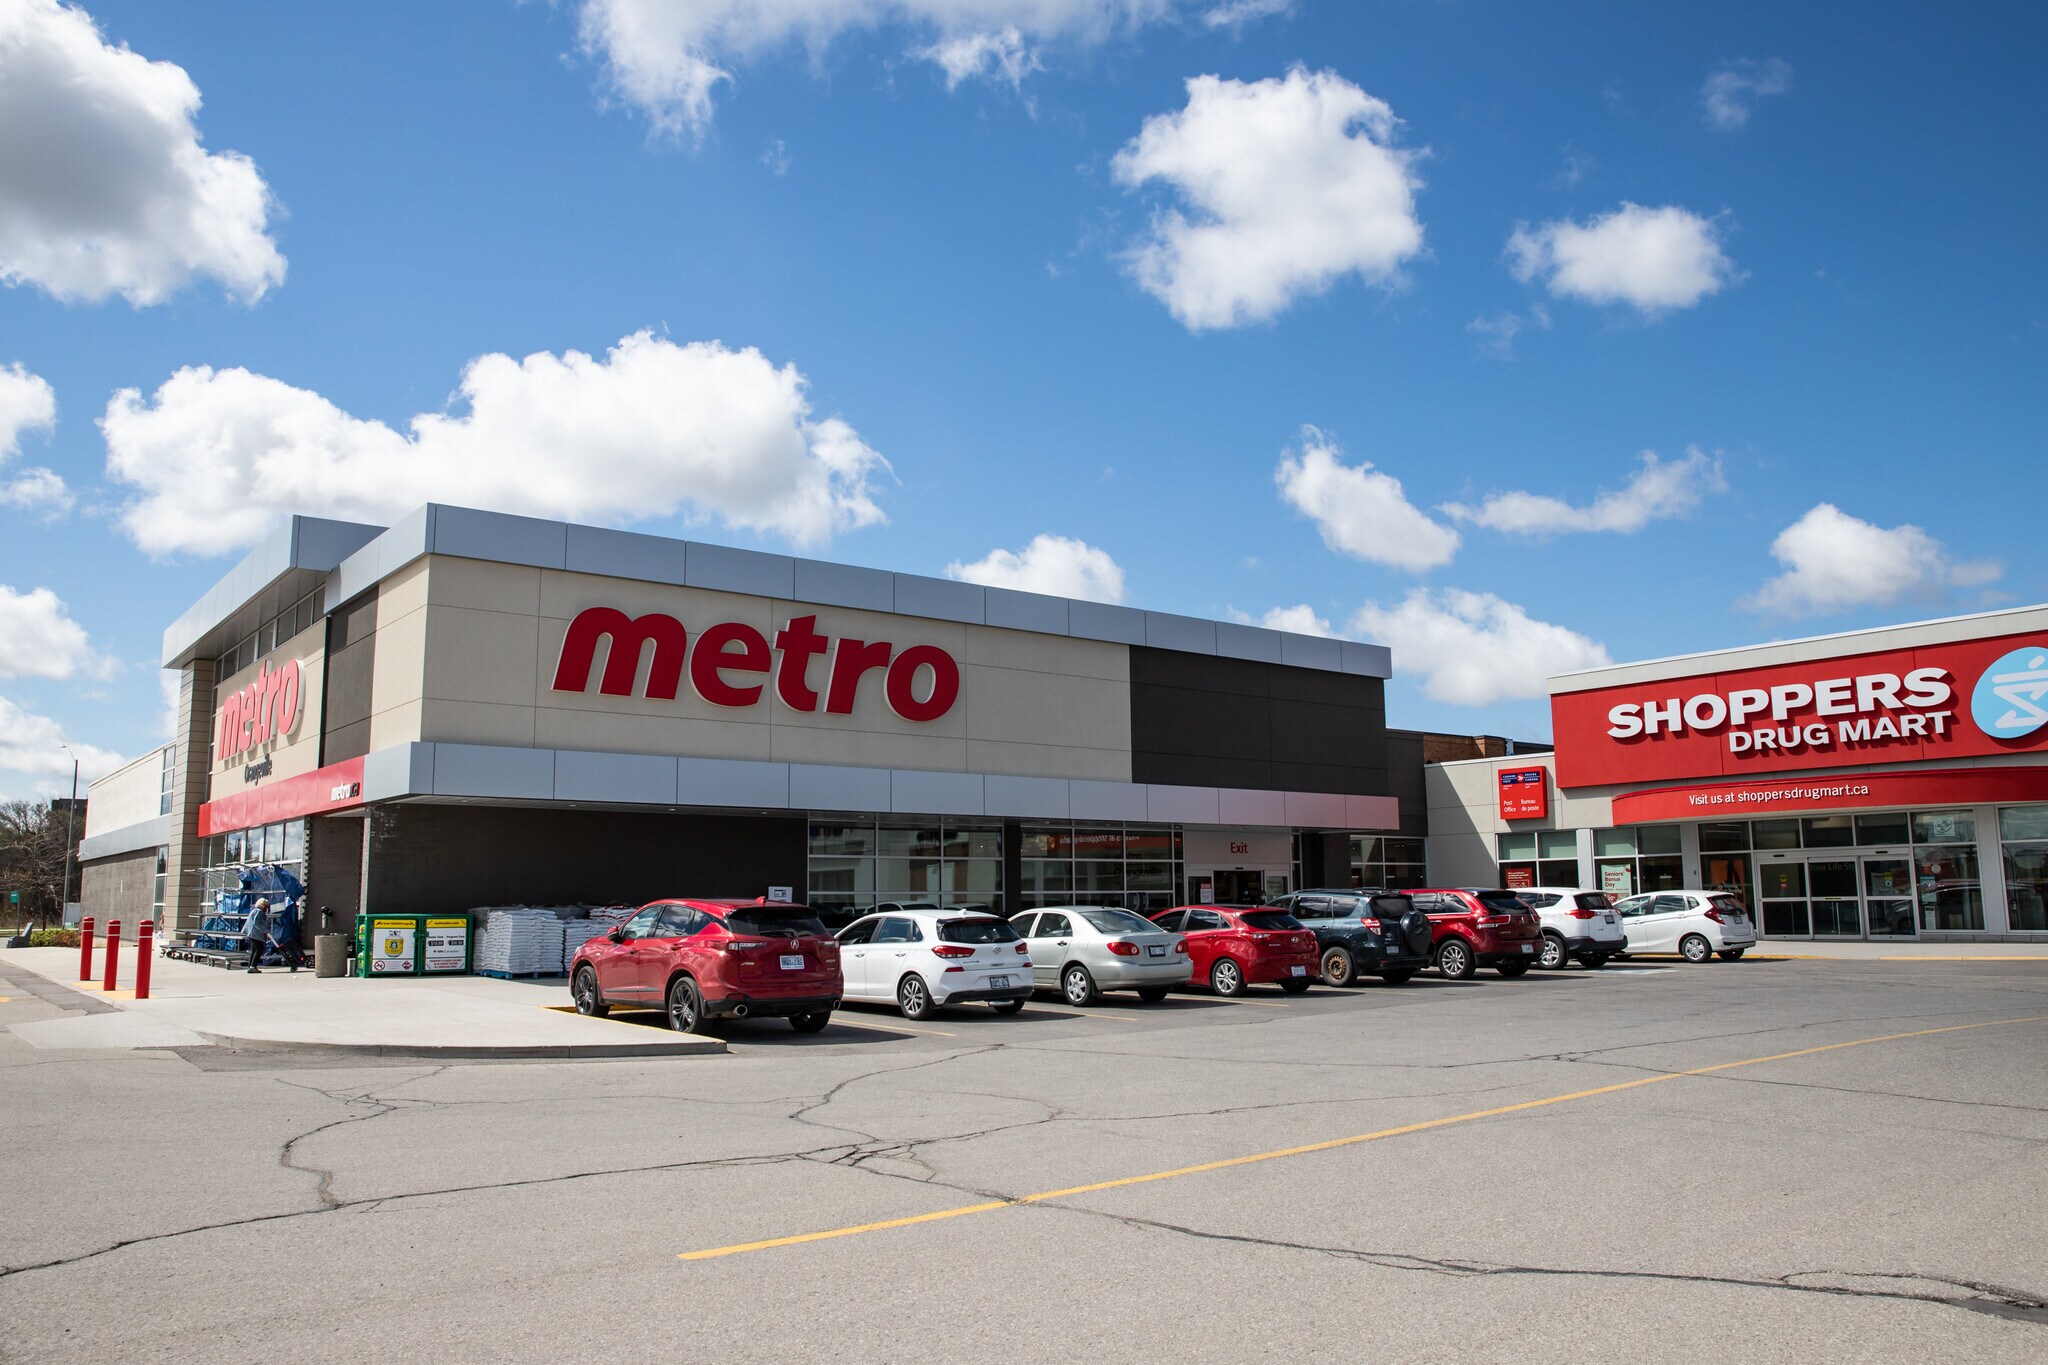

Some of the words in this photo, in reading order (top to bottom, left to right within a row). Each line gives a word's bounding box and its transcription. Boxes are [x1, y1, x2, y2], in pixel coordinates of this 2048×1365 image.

[551, 606, 960, 722] metro
[218, 658, 304, 761] metro
[1607, 667, 1951, 738] SHOPPERS
[1728, 723, 1829, 753] DRUG
[1838, 710, 1952, 743] MART
[244, 753, 272, 786] Orangeville
[1689, 793, 1708, 805] Visit
[1711, 795, 1723, 804] us
[1724, 792, 1735, 803] at
[1738, 784, 1869, 802] shoppersdrugmart.ca
[1230, 842, 1249, 854] Exit
[1828, 862, 1843, 871] Life
